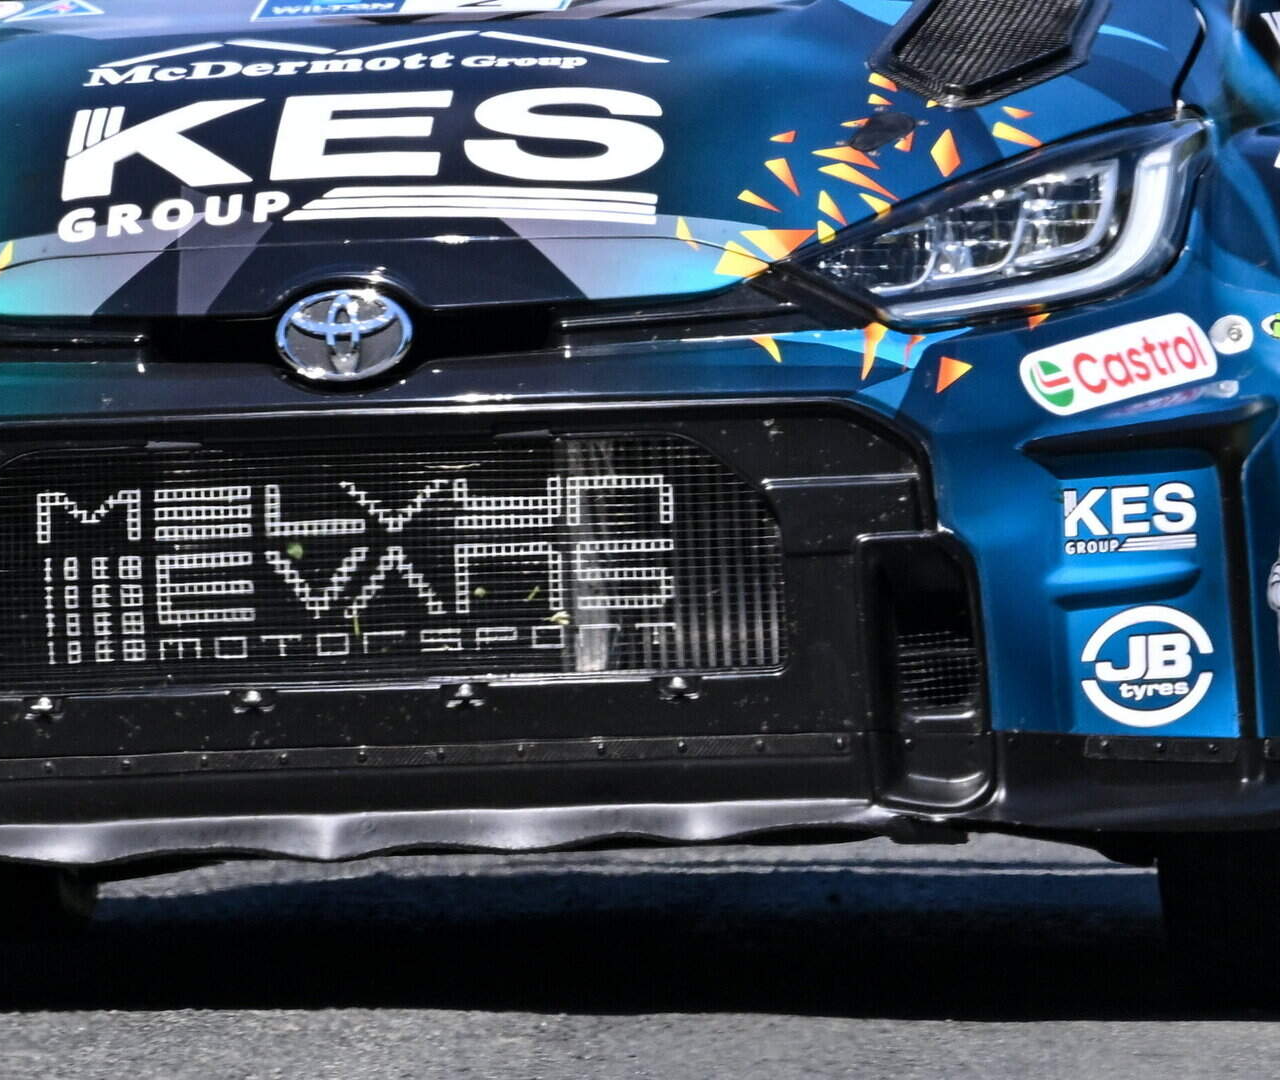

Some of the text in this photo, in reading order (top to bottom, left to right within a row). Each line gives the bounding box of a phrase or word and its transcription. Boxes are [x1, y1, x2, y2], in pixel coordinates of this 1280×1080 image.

[272, 2, 395, 15] WILTON
[83, 51, 588, 87] McDermott Group
[61, 87, 665, 202] KES
[57, 191, 290, 242] GROUP
[1072, 326, 1209, 393] Castrol
[1063, 482, 1198, 538] KES
[1064, 540, 1120, 555] GROUP
[1094, 633, 1193, 682] JB
[1119, 682, 1190, 702] tyres
